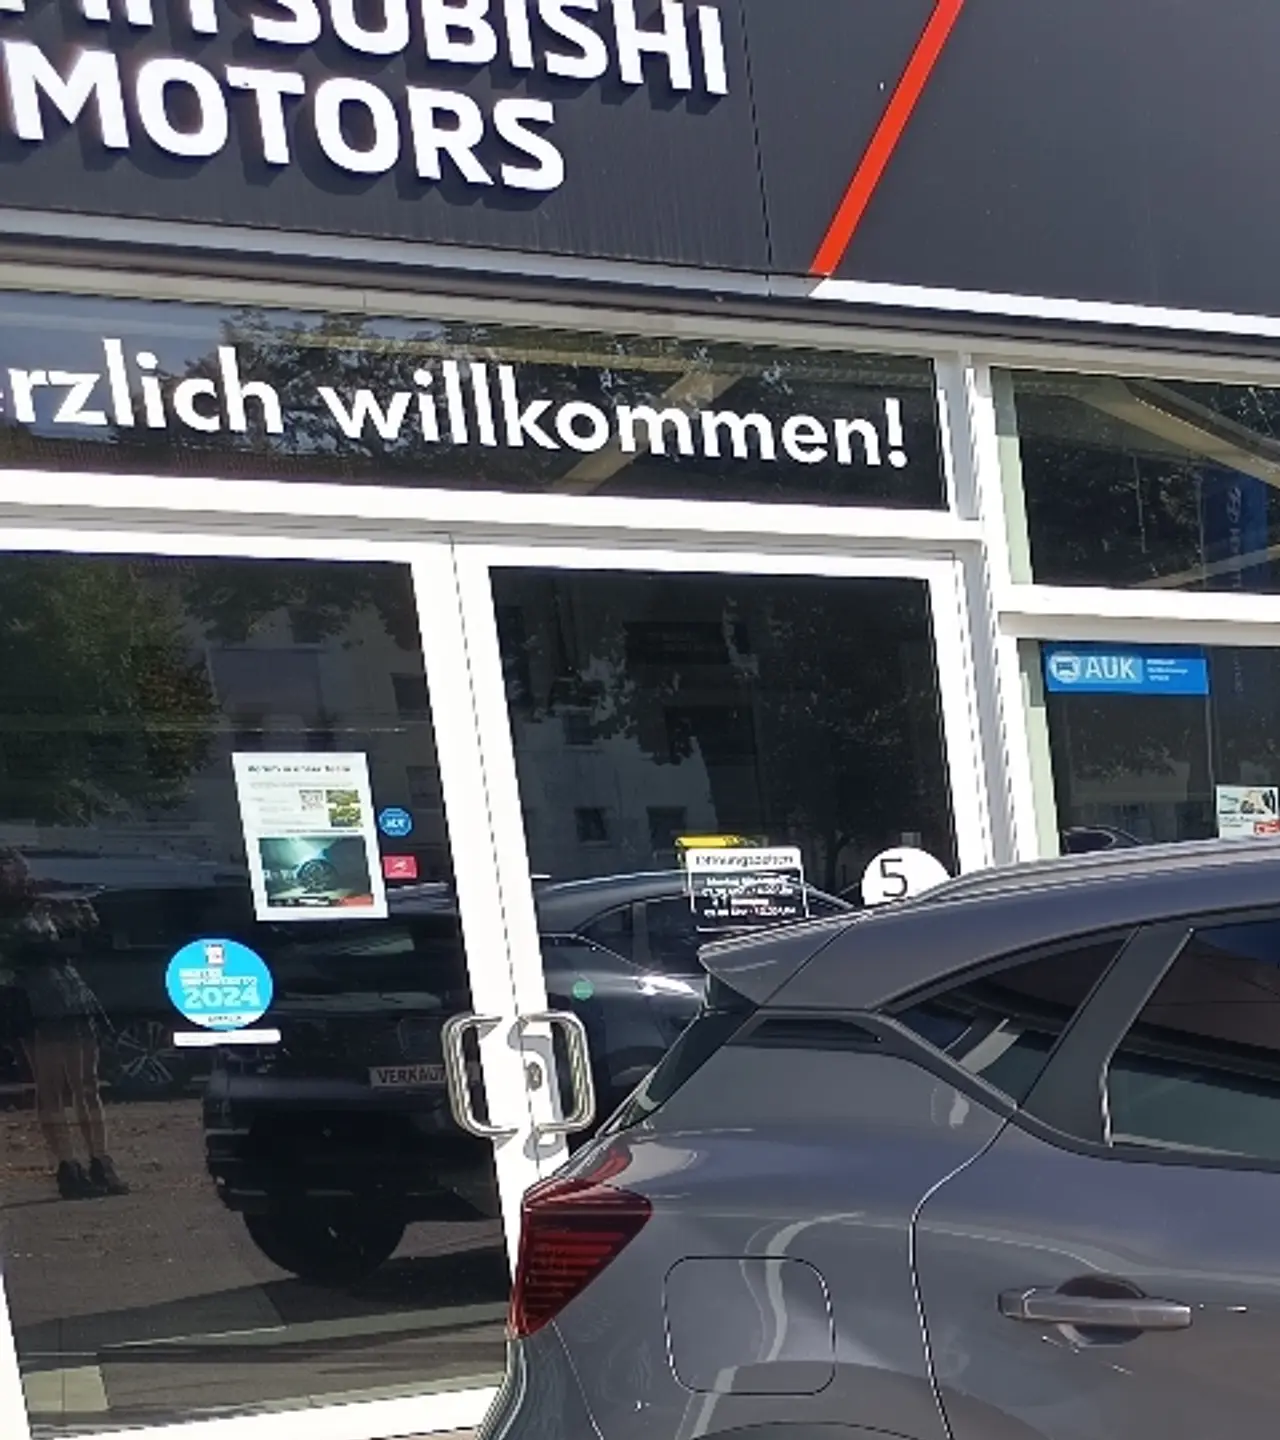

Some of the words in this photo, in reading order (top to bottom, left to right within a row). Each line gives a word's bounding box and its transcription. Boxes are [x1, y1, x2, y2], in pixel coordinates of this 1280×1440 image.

[0, 0, 729, 95] UBISHI
[2, 40, 566, 191] MOTORS
[0, 337, 284, 434] rzlich
[317, 360, 908, 468] willkommen!
[1085, 655, 1136, 680] AUK
[879, 857, 908, 898] 5
[183, 986, 262, 1009] 2024
